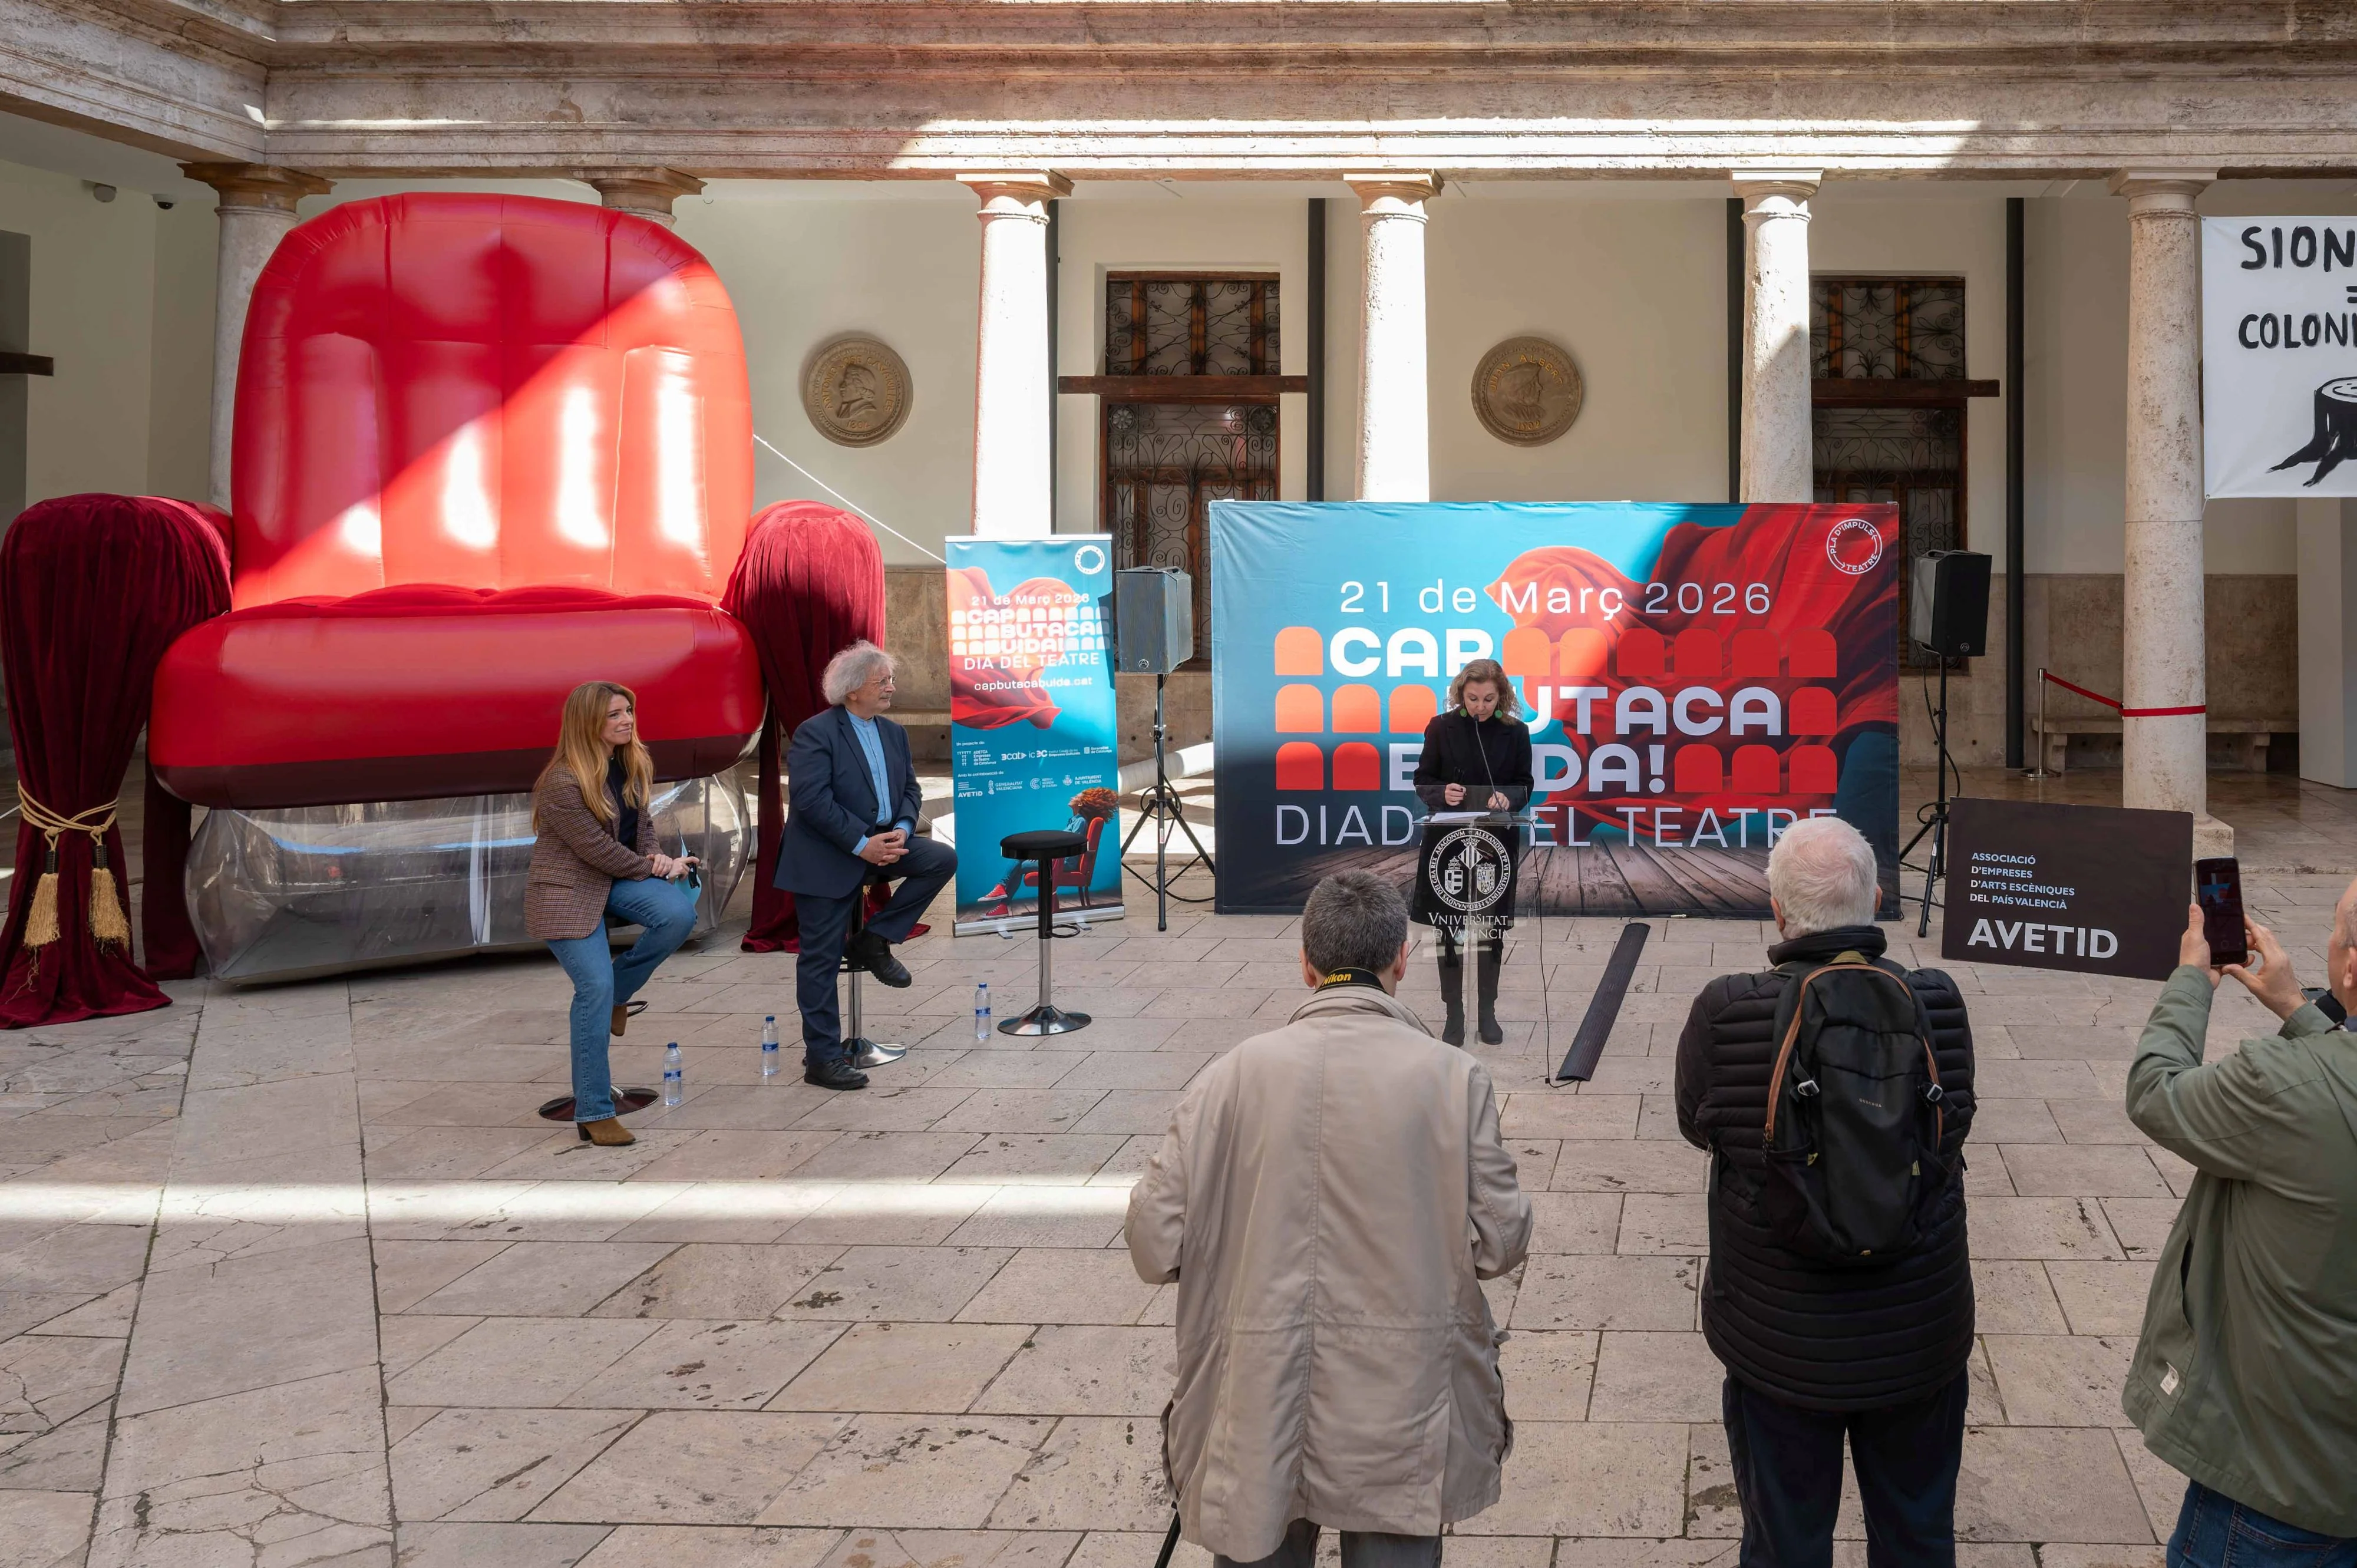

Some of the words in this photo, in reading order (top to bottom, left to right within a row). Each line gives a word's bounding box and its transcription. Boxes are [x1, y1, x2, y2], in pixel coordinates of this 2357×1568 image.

[2240, 226, 2355, 272] SION
[1489, 362, 1511, 392] JUAN
[1520, 354, 1564, 387] ALBERT
[1834, 521, 1875, 536] D'IMPULS
[1846, 553, 1878, 572] TEATRE
[972, 596, 988, 606] 21
[993, 594, 1010, 605] de
[1015, 595, 1051, 605] Març
[1055, 593, 1090, 604] 2026
[1340, 581, 1389, 613] 21
[1419, 579, 1477, 613] de
[1501, 582, 1623, 620] Març
[1645, 582, 1771, 614] 2026
[966, 609, 1015, 625] CAP
[1001, 621, 1095, 639] BUTACA
[985, 638, 1064, 655] BUIDA!
[1330, 627, 1493, 677] CAP
[964, 657, 994, 671] DIA
[1000, 656, 1032, 669] DEL
[1038, 652, 1100, 667] TEATRE
[974, 676, 1093, 692] capbutacabuida.cat
[1447, 686, 1781, 735] UTACA
[1276, 805, 1422, 846] DIAD
[1435, 830, 1465, 854] ARAGONVM
[1475, 830, 1504, 855] ALEXANDER
[1971, 852, 2036, 865] ASSOCIACIÓ
[1971, 866, 2033, 878] D'EMPRESES
[1434, 884, 1443, 894] DEI
[1970, 879, 2007, 890] D'ARTS
[2009, 883, 2075, 896] ESCÈNIQUES
[1969, 893, 1989, 903] DEL
[1992, 894, 2013, 905] PAÍS
[2015, 896, 2068, 910] VALENCIÀ
[1967, 918, 2118, 959] AVETID
